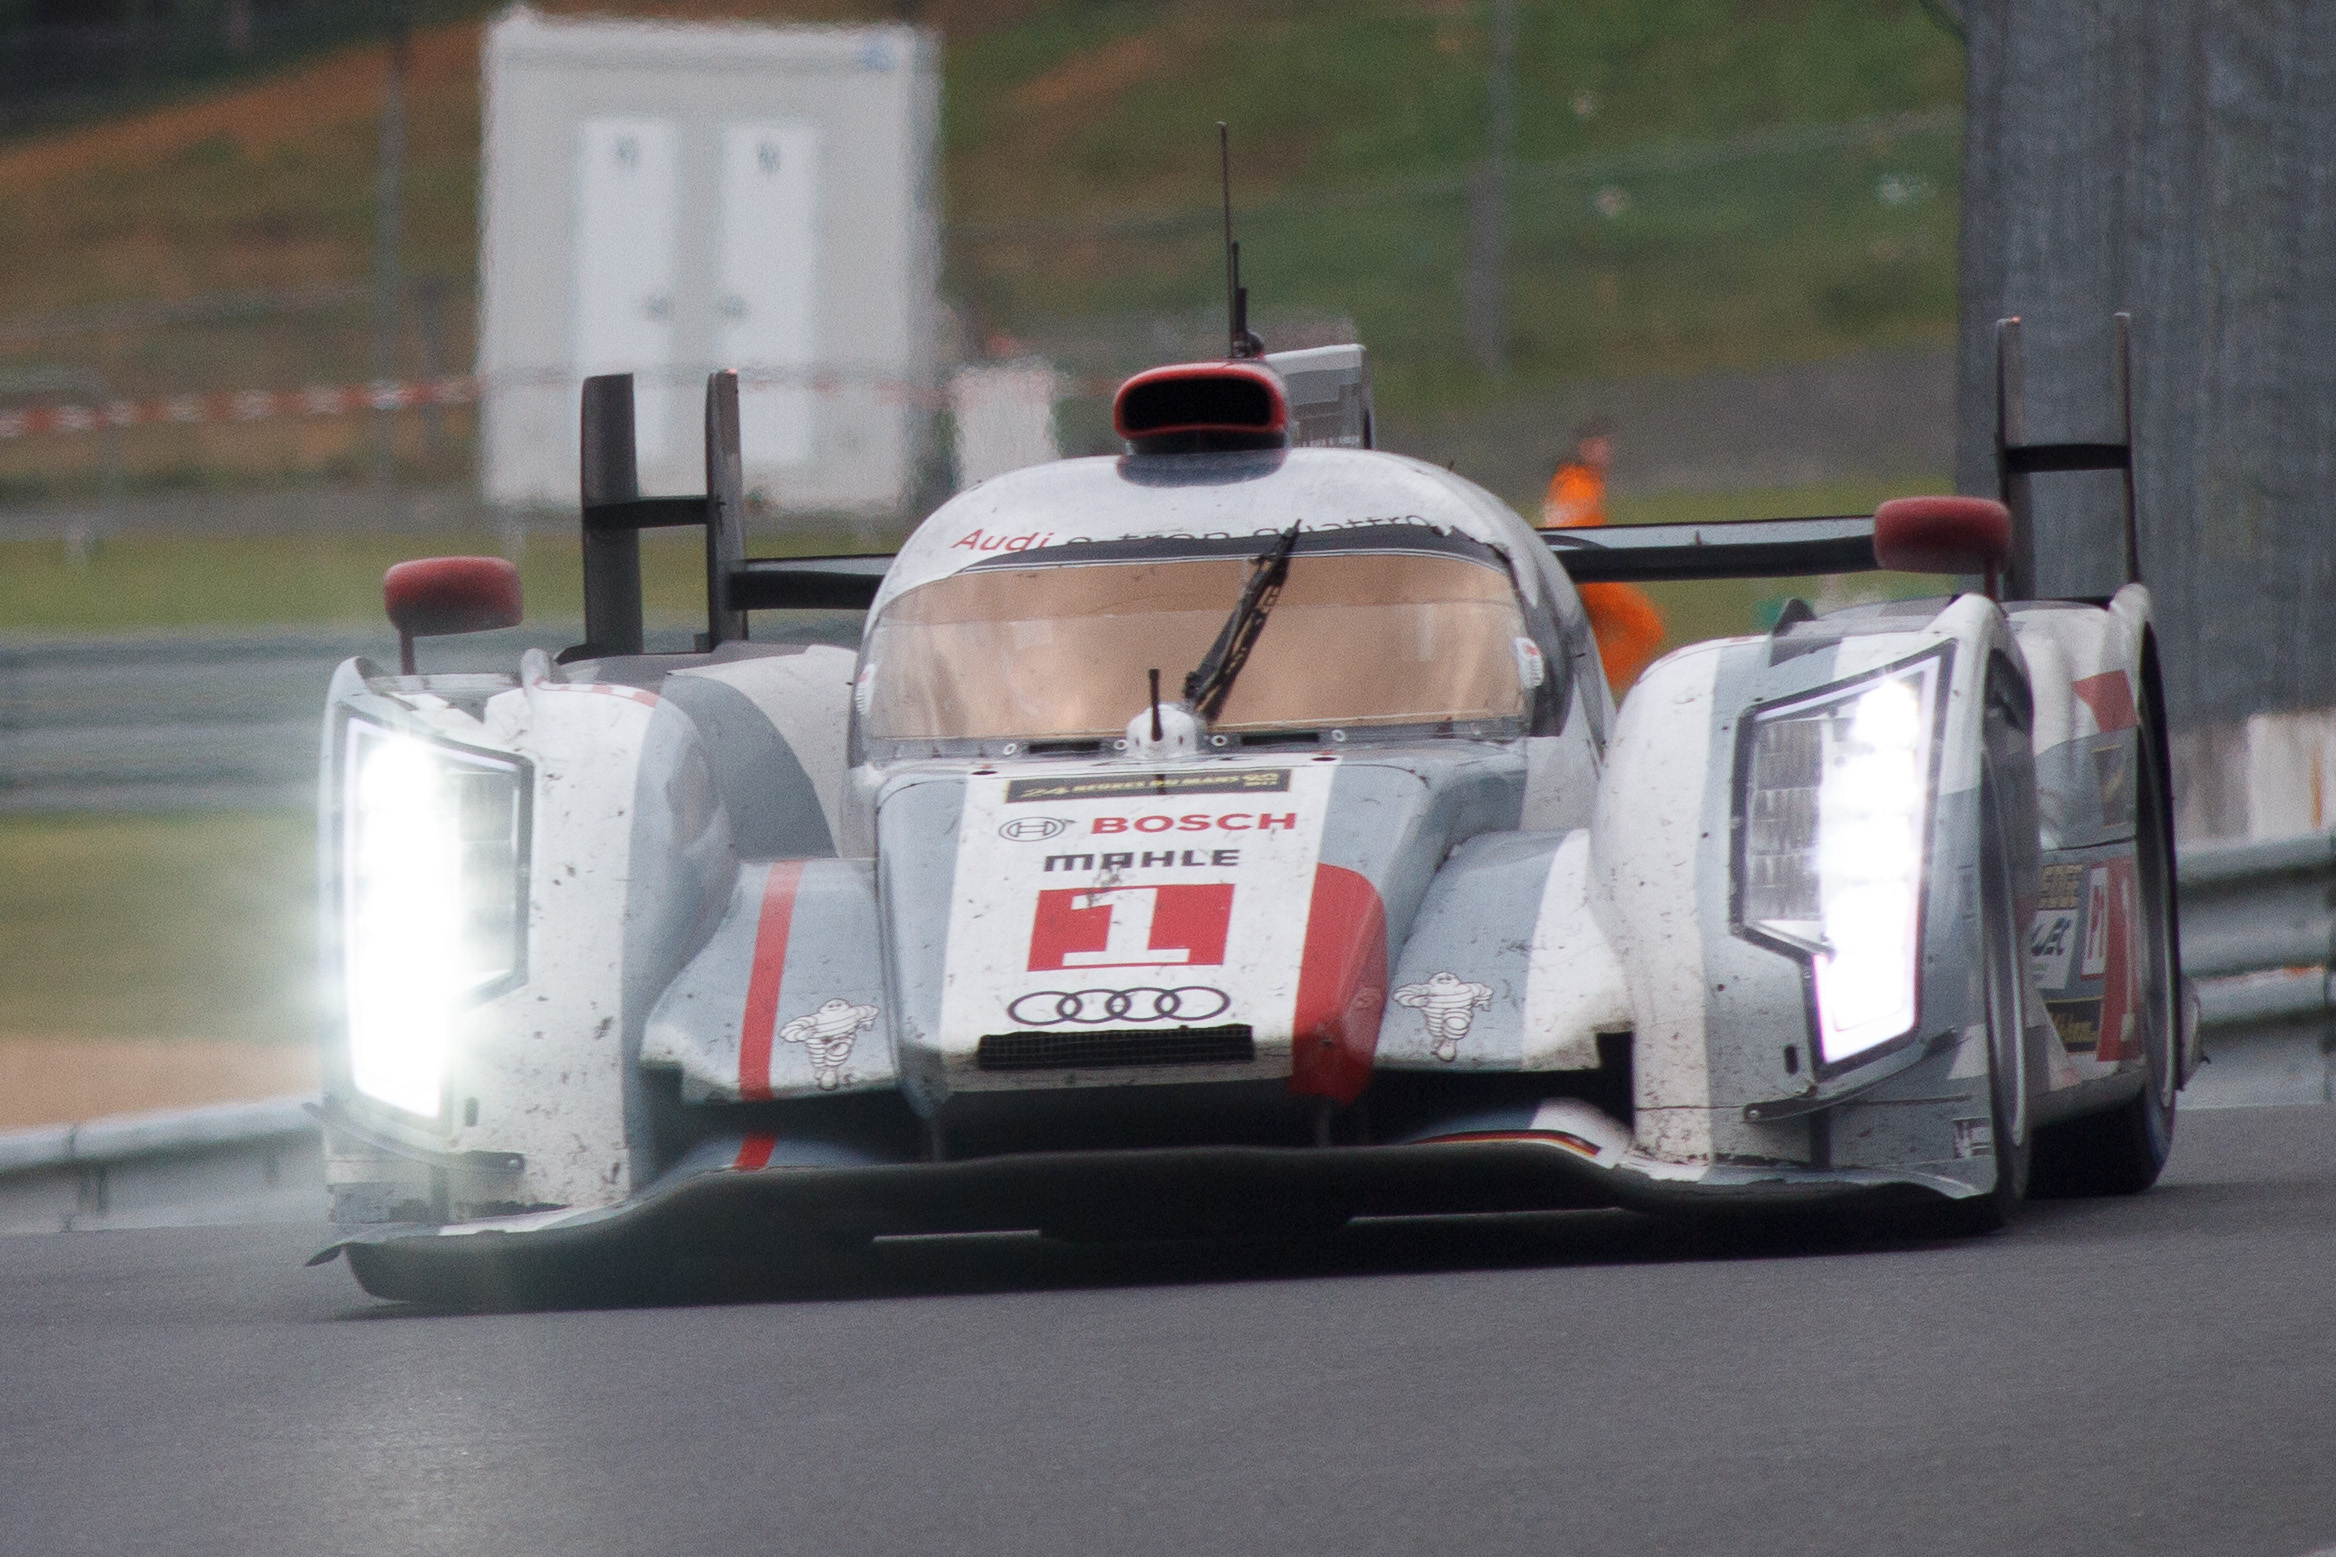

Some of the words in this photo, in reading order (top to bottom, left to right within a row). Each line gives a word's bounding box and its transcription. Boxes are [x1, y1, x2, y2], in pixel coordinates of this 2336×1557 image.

[951, 528, 1055, 552] Audi
[1091, 813, 1297, 834] BOSCH
[1044, 849, 1240, 872] MAHLE
[1062, 888, 1190, 966] 1
